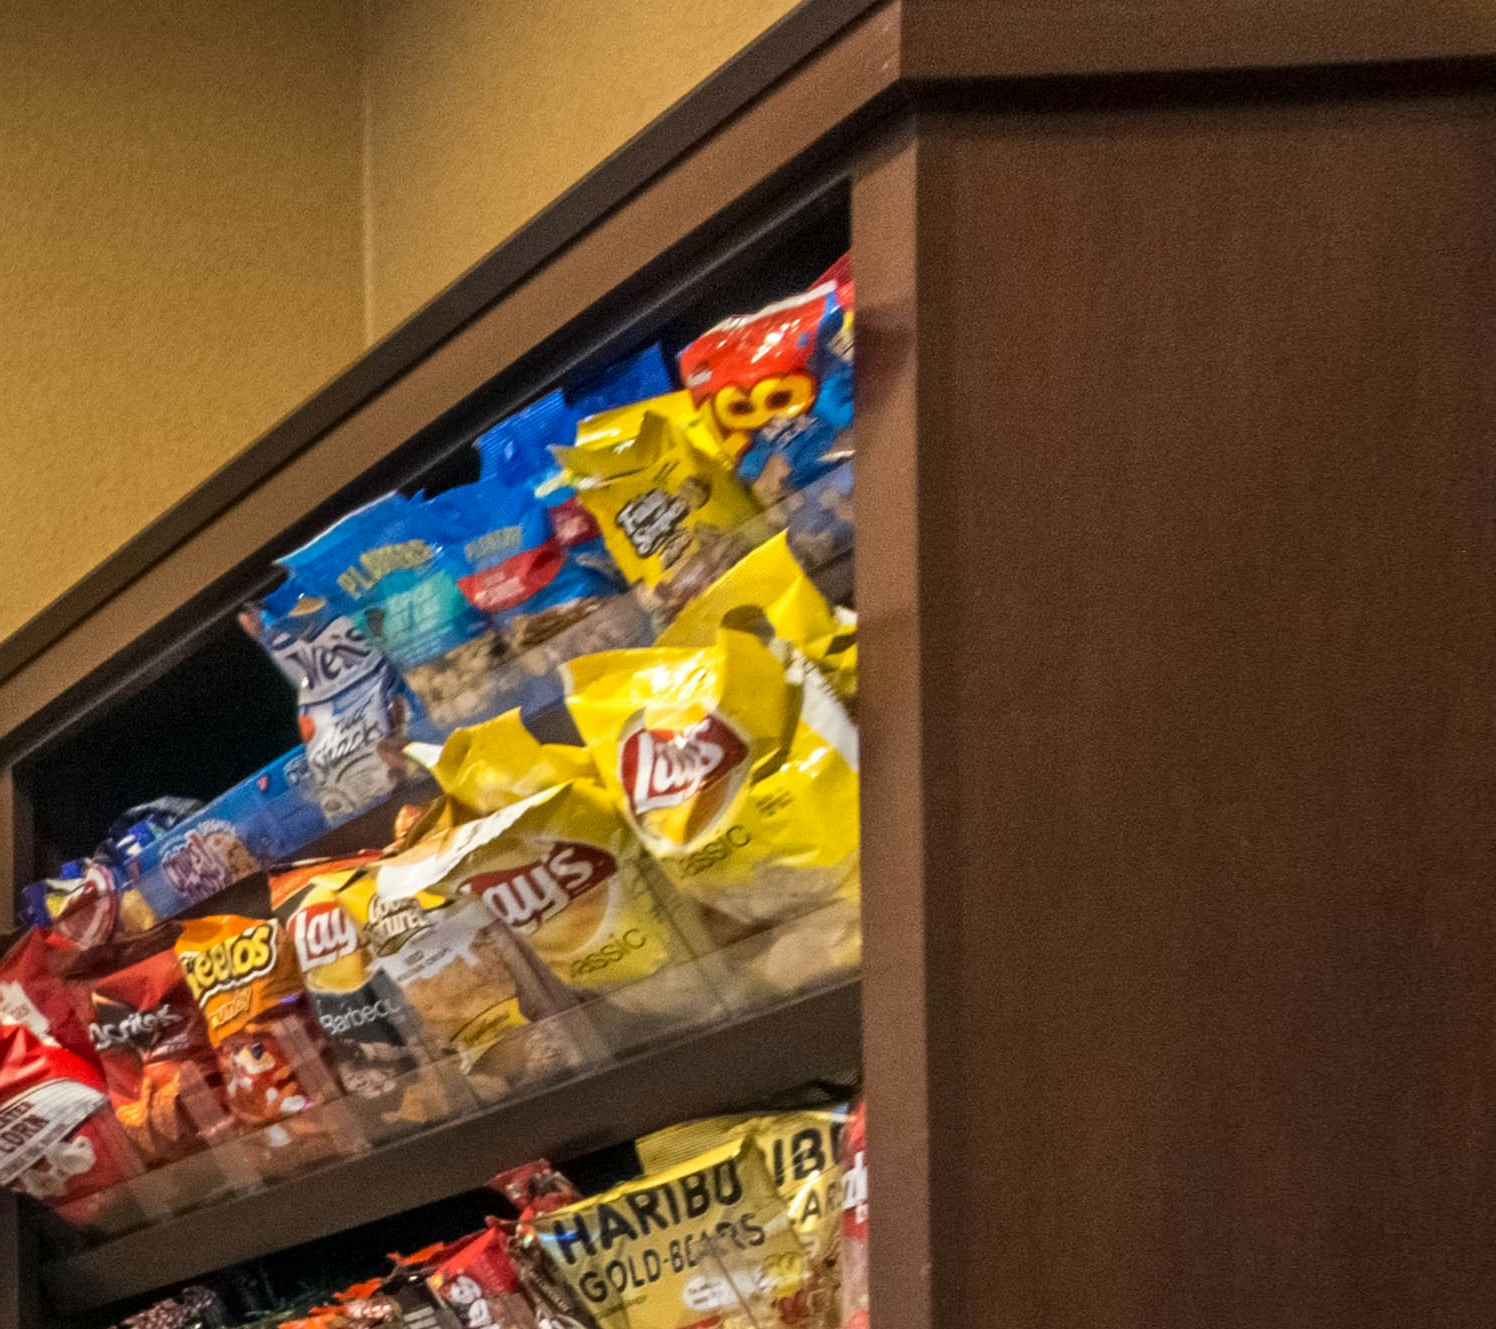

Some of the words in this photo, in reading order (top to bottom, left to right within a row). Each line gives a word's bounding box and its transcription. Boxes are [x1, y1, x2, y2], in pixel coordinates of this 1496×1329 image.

[482, 843, 595, 937] ay's
[552, 1162, 742, 1266] HARIBO
[579, 1211, 767, 1305] GOLD-BEARS
